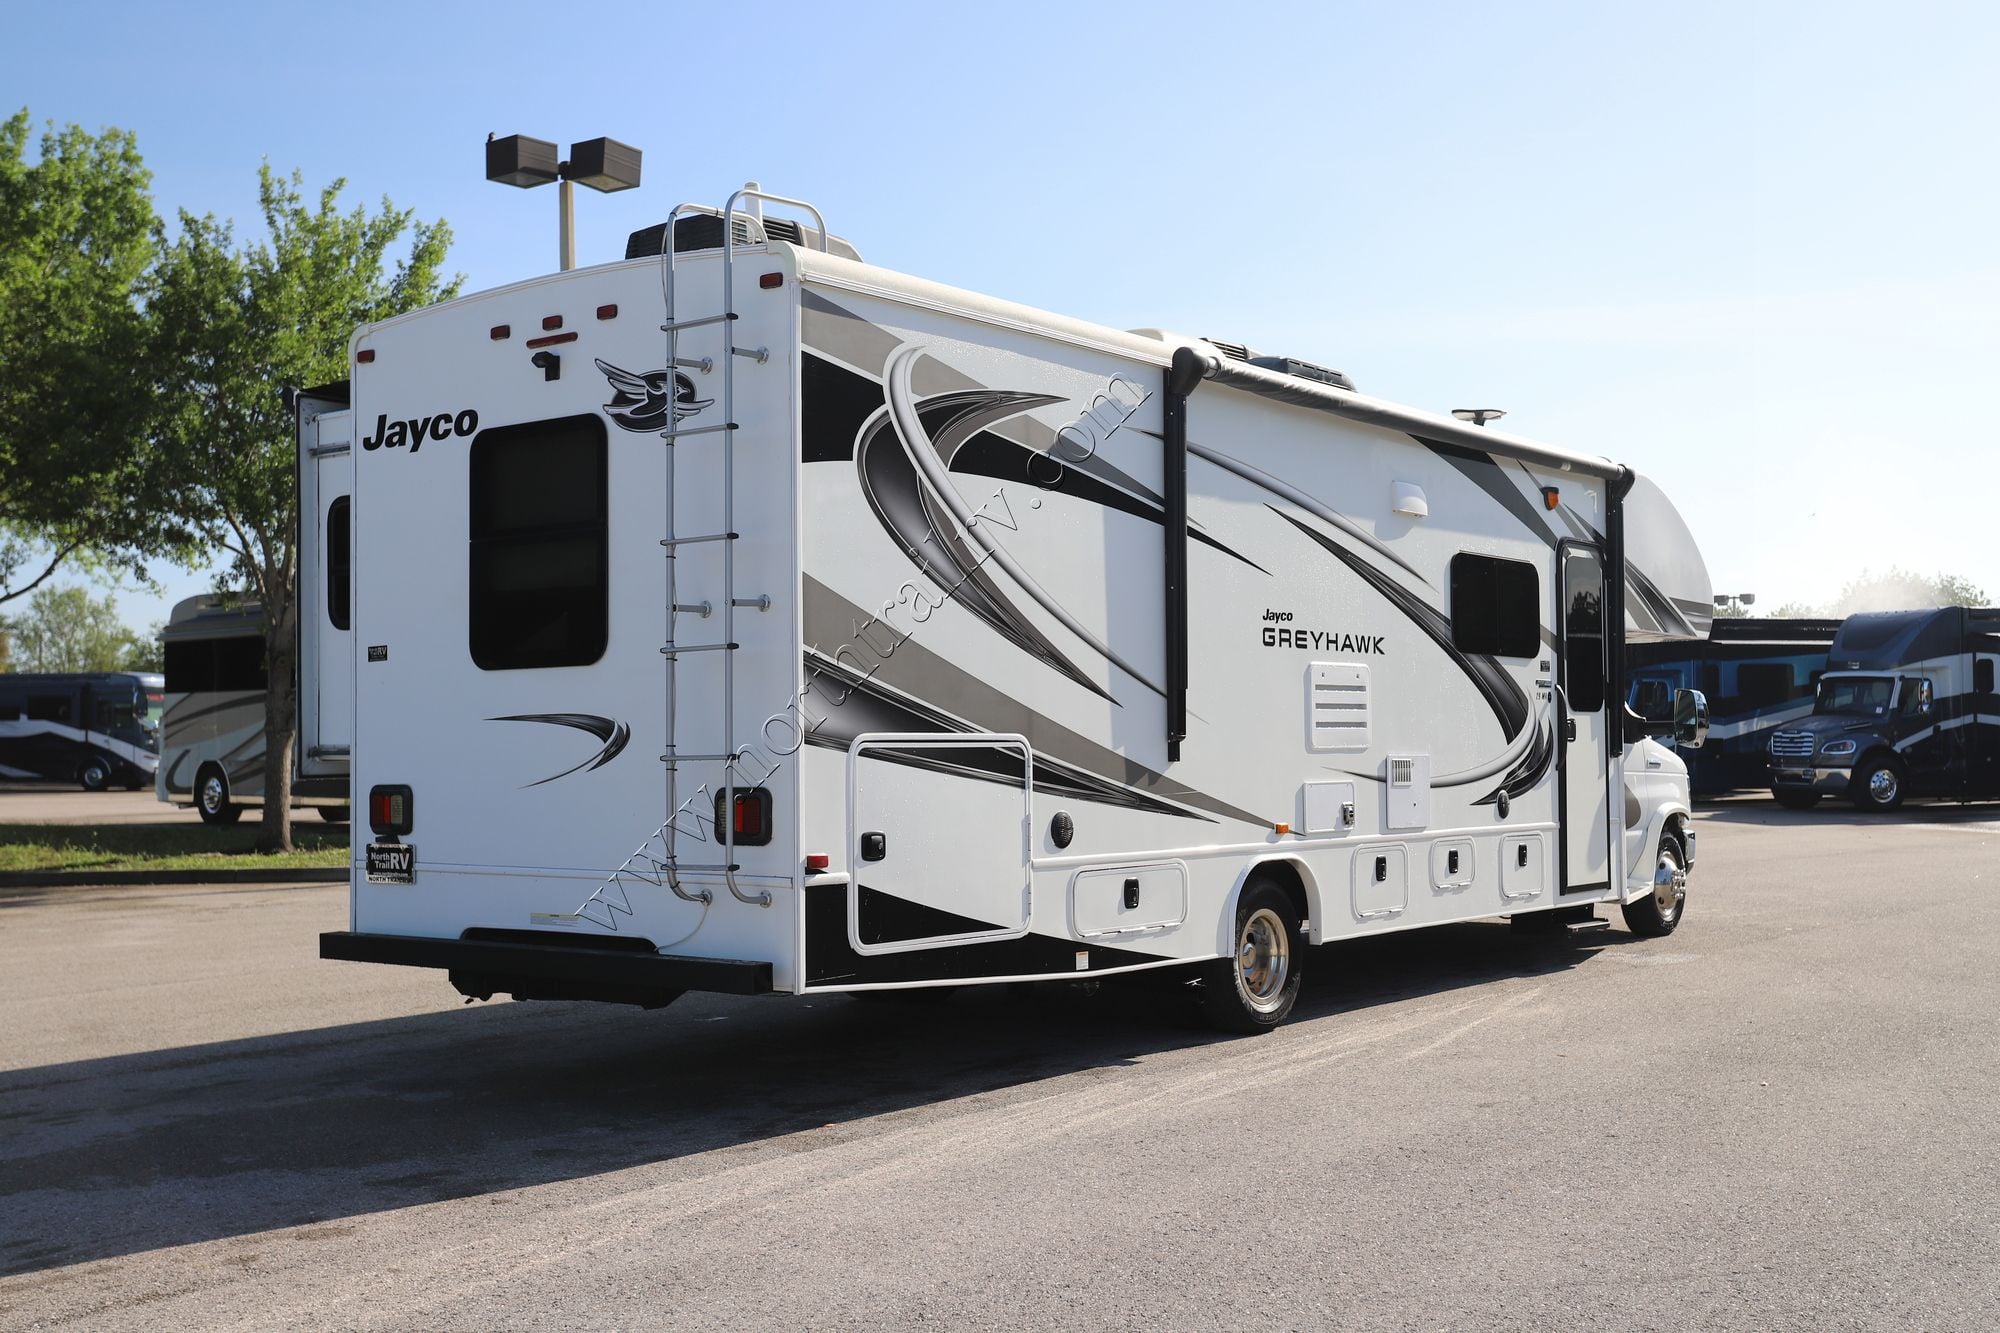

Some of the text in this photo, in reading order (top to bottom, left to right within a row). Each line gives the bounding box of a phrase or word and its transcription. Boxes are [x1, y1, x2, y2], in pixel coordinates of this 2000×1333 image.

[363, 409, 478, 453] Jayco
[1262, 608, 1293, 624] Jayco
[1262, 627, 1385, 655] GREYHAWK
[371, 852, 390, 861] North
[374, 860, 390, 869] Trail
[390, 852, 410, 870] RV
